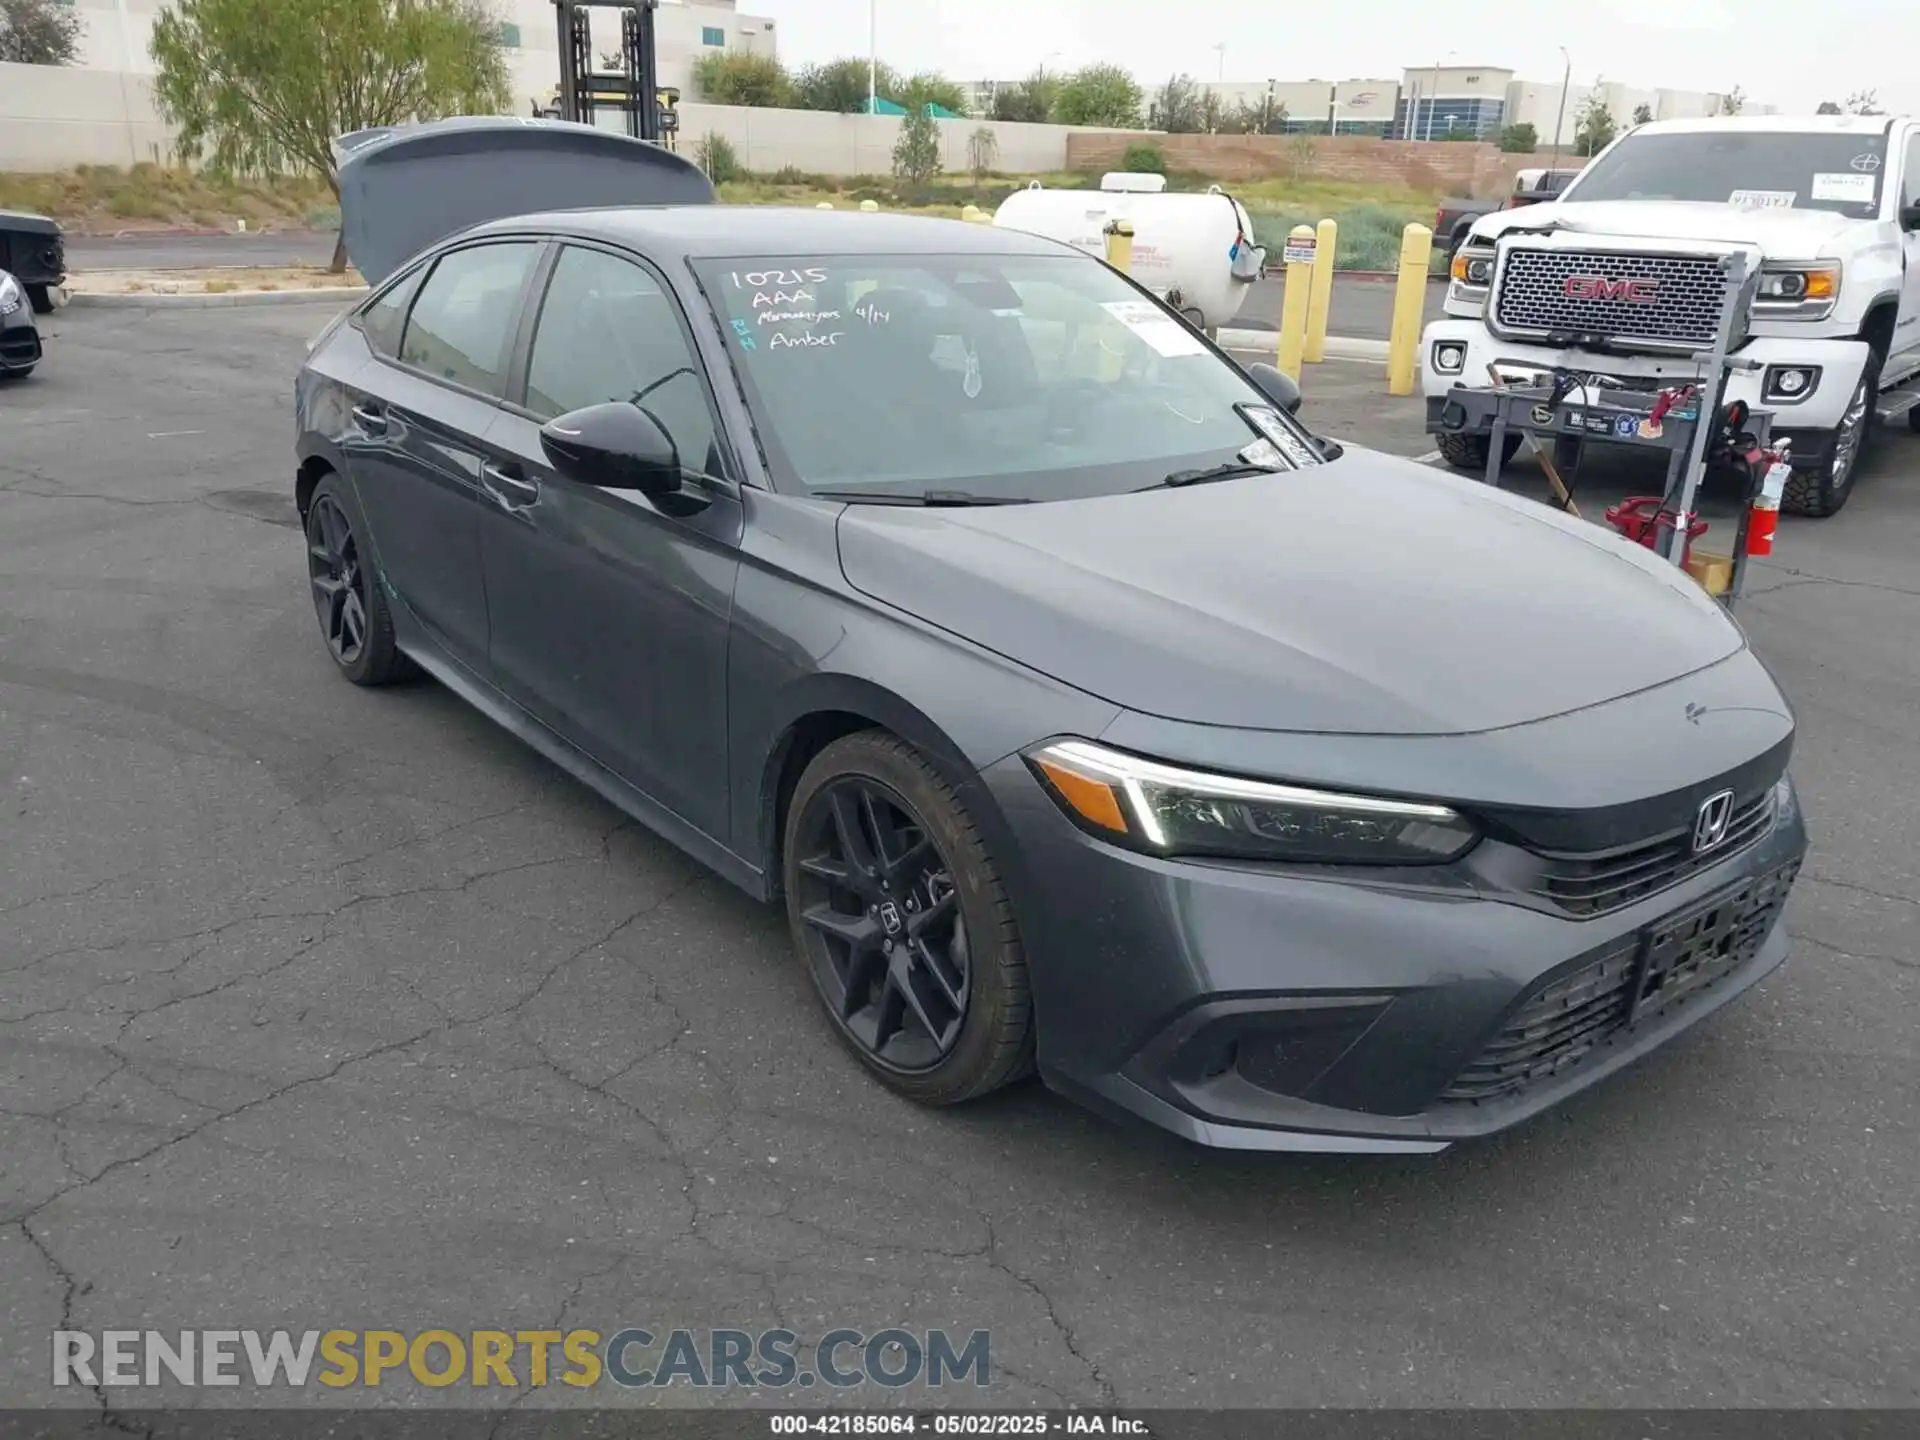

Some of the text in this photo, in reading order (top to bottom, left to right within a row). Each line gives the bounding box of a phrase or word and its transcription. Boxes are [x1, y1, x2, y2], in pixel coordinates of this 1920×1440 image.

[732, 267, 828, 288] 10215
[751, 289, 817, 309] AAA
[1564, 275, 1660, 304] GMC
[855, 303, 890, 325] 4/14
[770, 330, 845, 350] Amber
